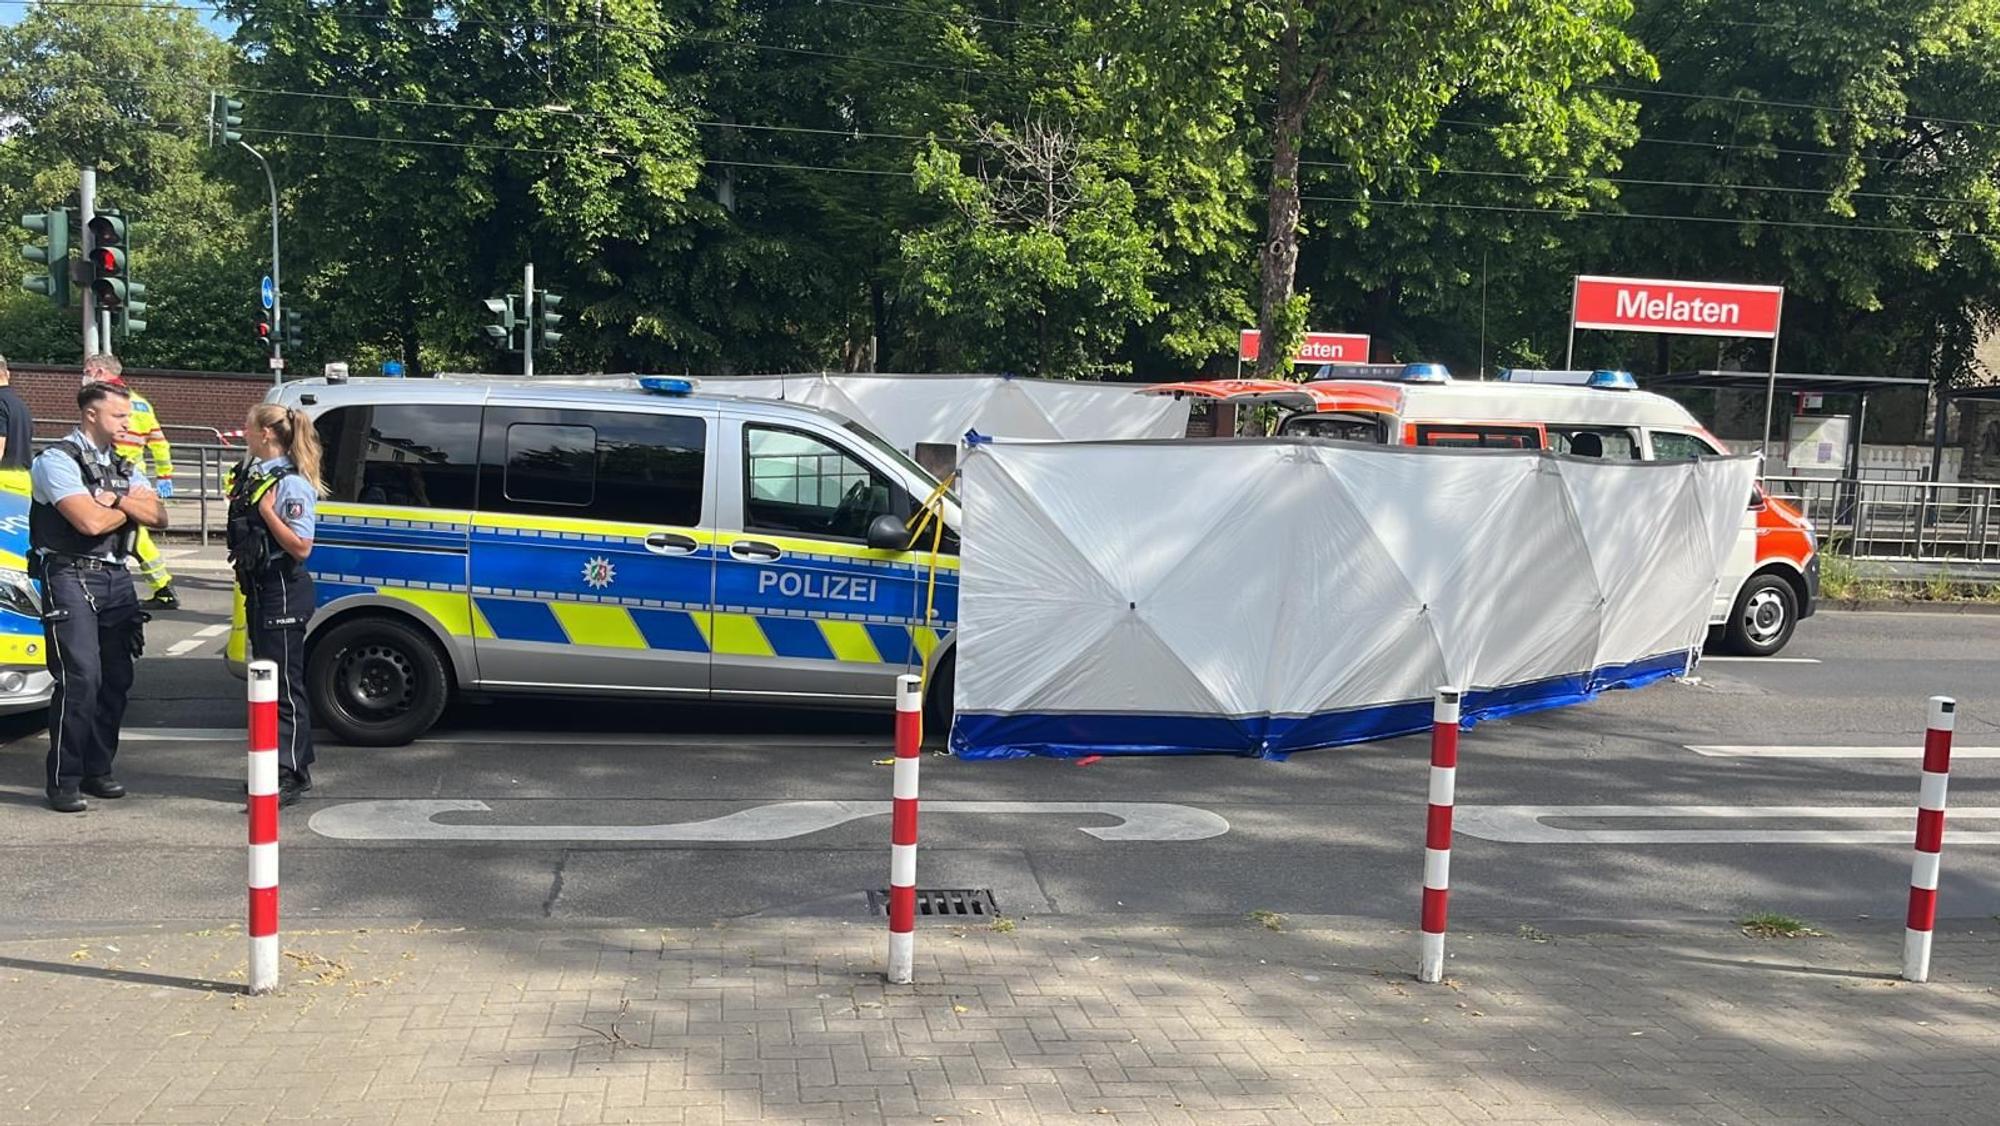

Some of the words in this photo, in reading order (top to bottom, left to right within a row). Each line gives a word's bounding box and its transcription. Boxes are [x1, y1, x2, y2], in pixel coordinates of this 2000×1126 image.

[1616, 289, 1739, 324] Melaten
[1301, 342, 1344, 358] aten
[758, 570, 877, 602] POLIZEI
